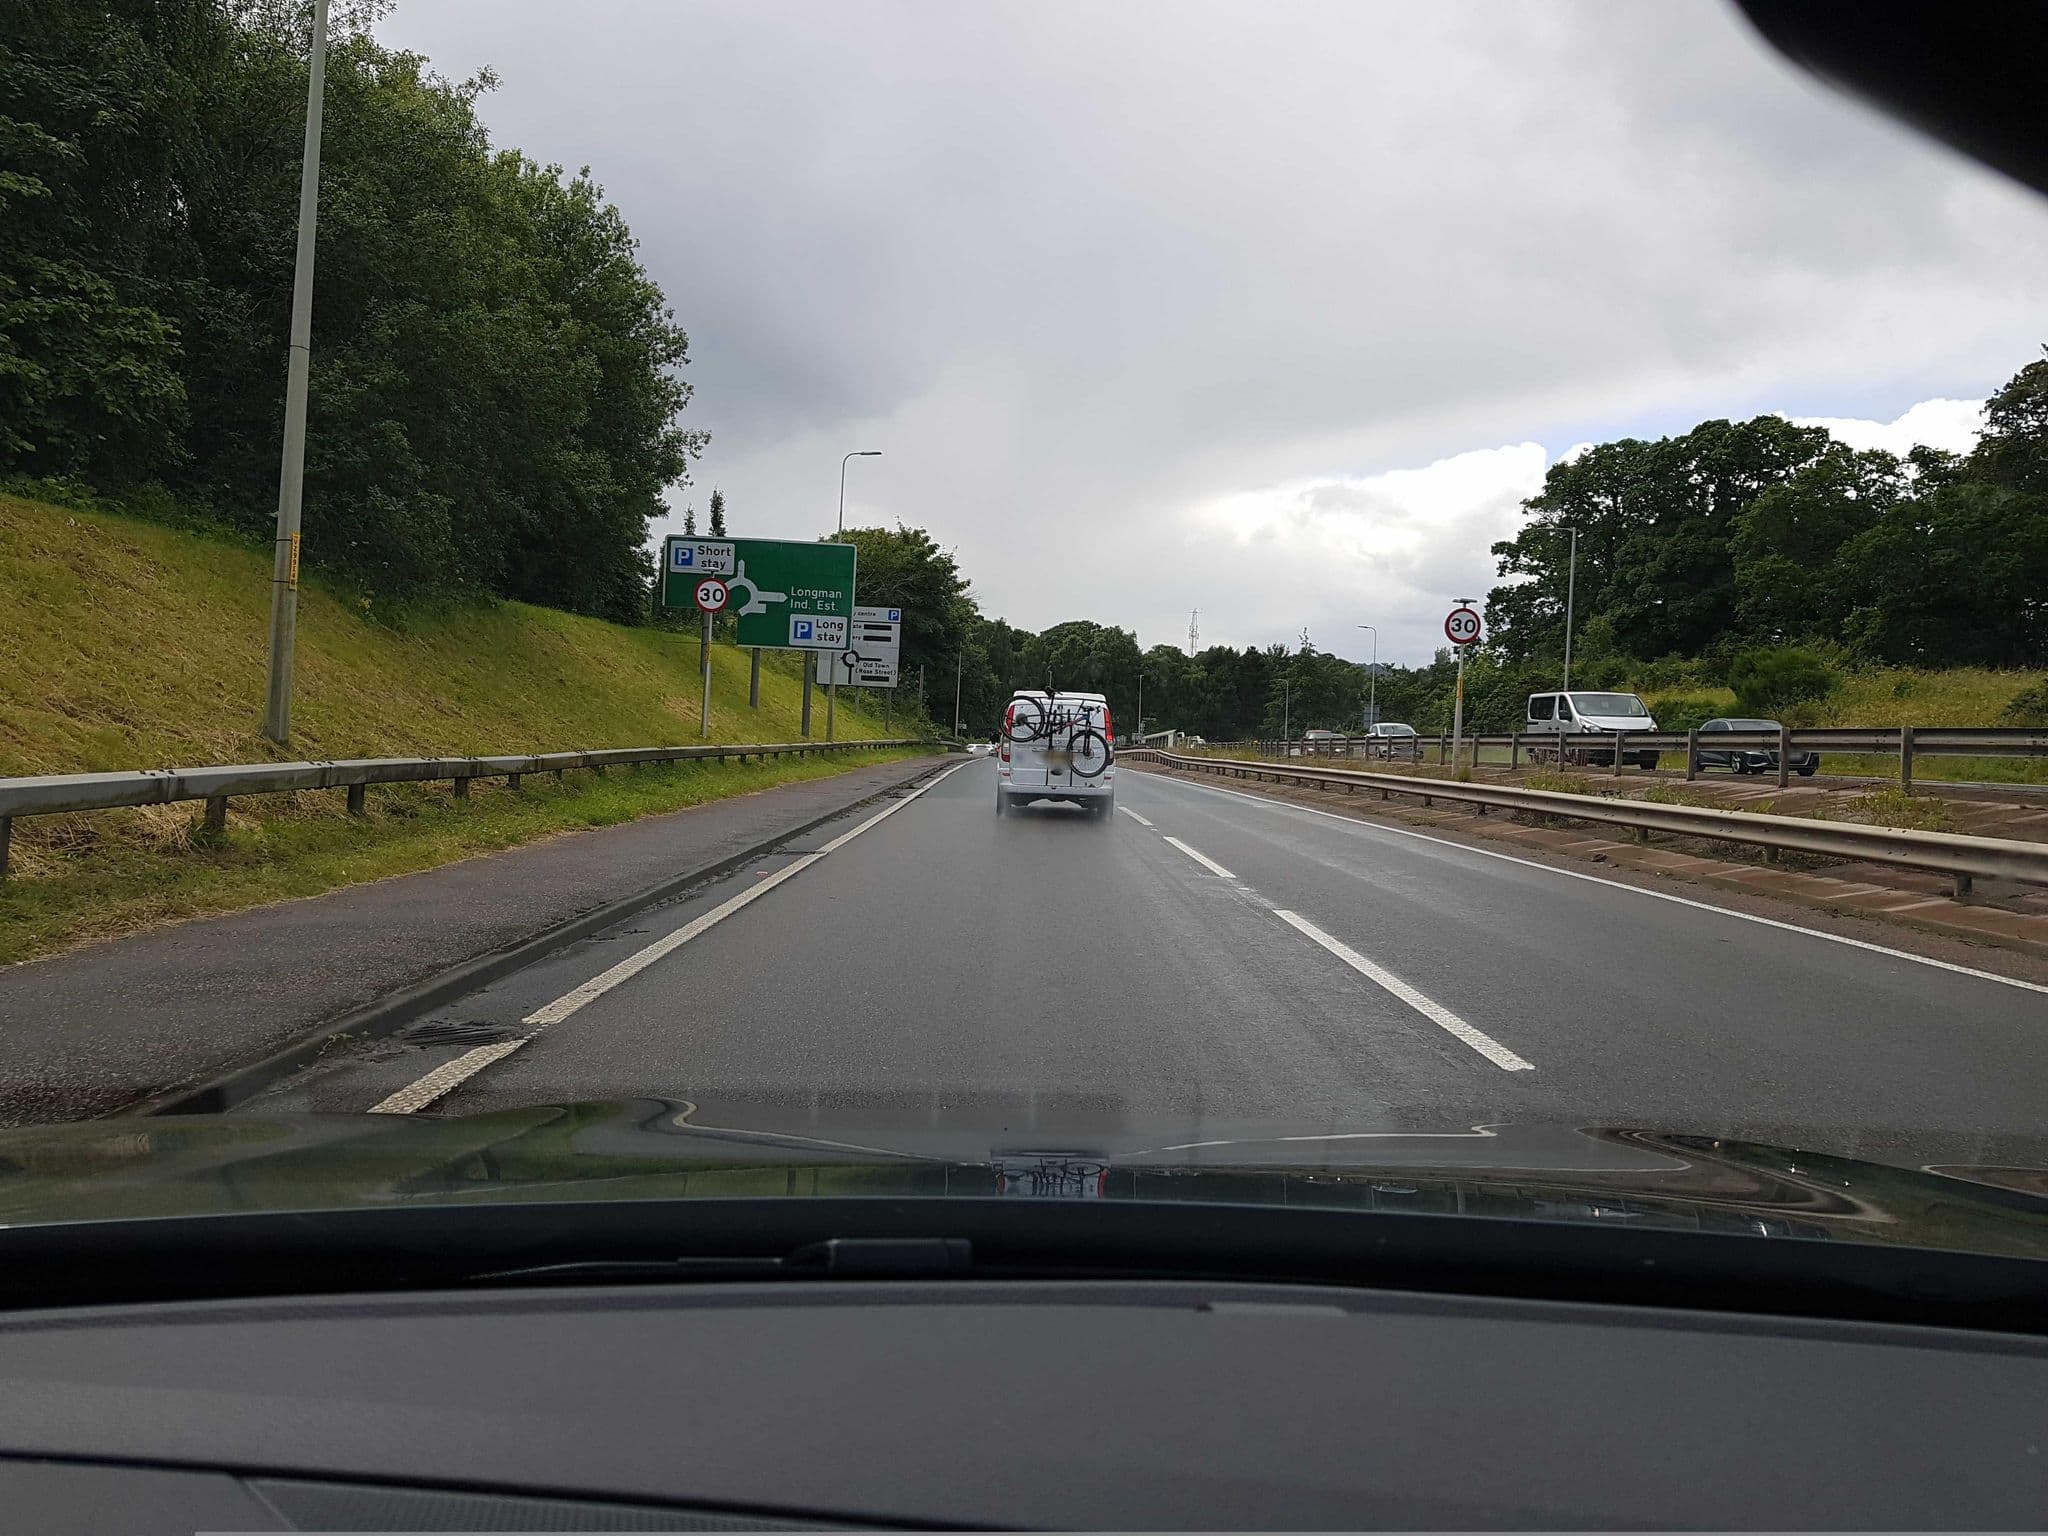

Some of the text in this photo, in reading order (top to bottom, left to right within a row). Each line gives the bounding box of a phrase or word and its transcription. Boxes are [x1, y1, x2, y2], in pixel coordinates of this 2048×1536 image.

[677, 548, 691, 565] P
[697, 545, 732, 557] Short
[701, 559, 727, 570] stay
[699, 587, 725, 603] 30
[791, 585, 842, 600] Longman
[790, 598, 839, 611] Ind. Est.
[796, 622, 809, 638] P
[816, 618, 844, 632] Long
[1451, 617, 1476, 634] 30
[816, 631, 842, 644] stay
[855, 667, 897, 676] (Rose Street)
